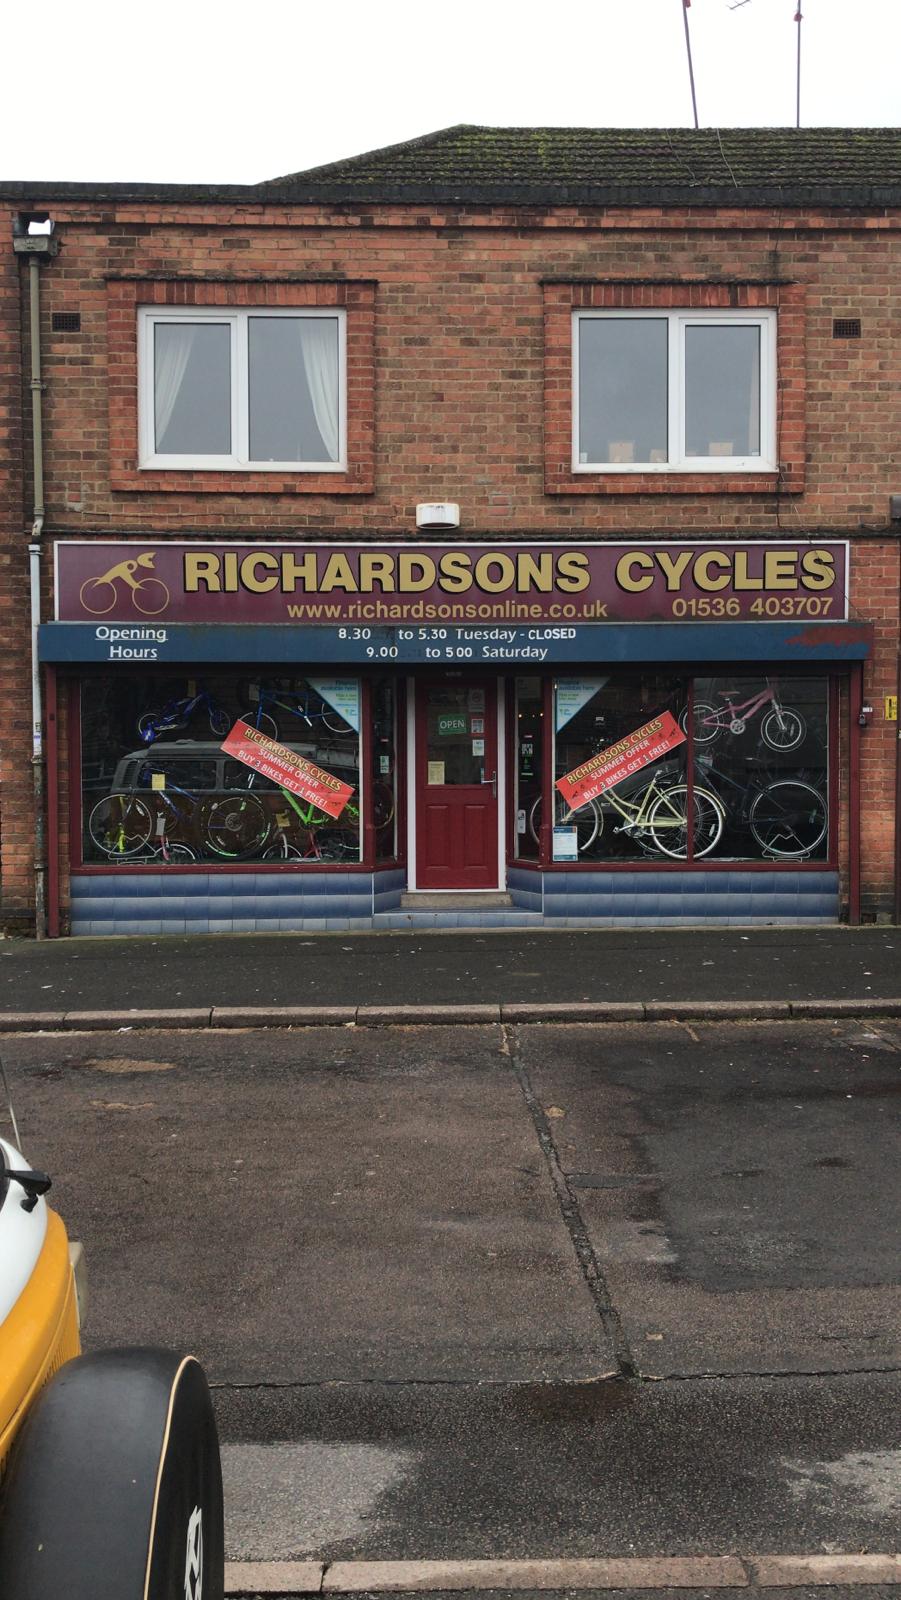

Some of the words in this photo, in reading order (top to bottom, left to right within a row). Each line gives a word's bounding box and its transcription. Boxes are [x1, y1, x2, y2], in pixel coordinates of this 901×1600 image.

[183, 551, 591, 594] RICHARDSONS
[614, 550, 837, 593] CYCLES
[287, 600, 608, 619] www.richardsonsonline.co.uk
[672, 597, 740, 617] 01536
[750, 597, 833, 617] 403707
[95, 626, 168, 643] Opening
[338, 628, 371, 640] 8.30
[398, 629, 414, 640] to
[418, 628, 447, 640] 5.30
[455, 628, 517, 643] Tuesday
[528, 628, 576, 640] CLOSED
[109, 645, 158, 661] Hours
[366, 646, 398, 658] 9.00
[425, 647, 441, 658] to
[482, 645, 548, 661] Saturday
[440, 719, 465, 729] OPEN
[245, 728, 311, 772] RICHARDSONS
[310, 767, 342, 792] CYCLES
[566, 740, 630, 784] RICHARDSONS
[630, 719, 663, 744] CYCLES
[590, 755, 626, 780] SUMMER
[625, 740, 650, 758] OFFER
[238, 750, 256, 764] BUY
[261, 763, 283, 780] BIKES
[283, 777, 299, 791] GET
[305, 791, 327, 808] FREE!
[258, 749, 294, 774] SUMMER
[295, 770, 319, 788] OFFER
[583, 785, 599, 800] BUY
[605, 767, 628, 785] BIKES
[627, 758, 642, 771] GET
[649, 740, 671, 758] FREE!
